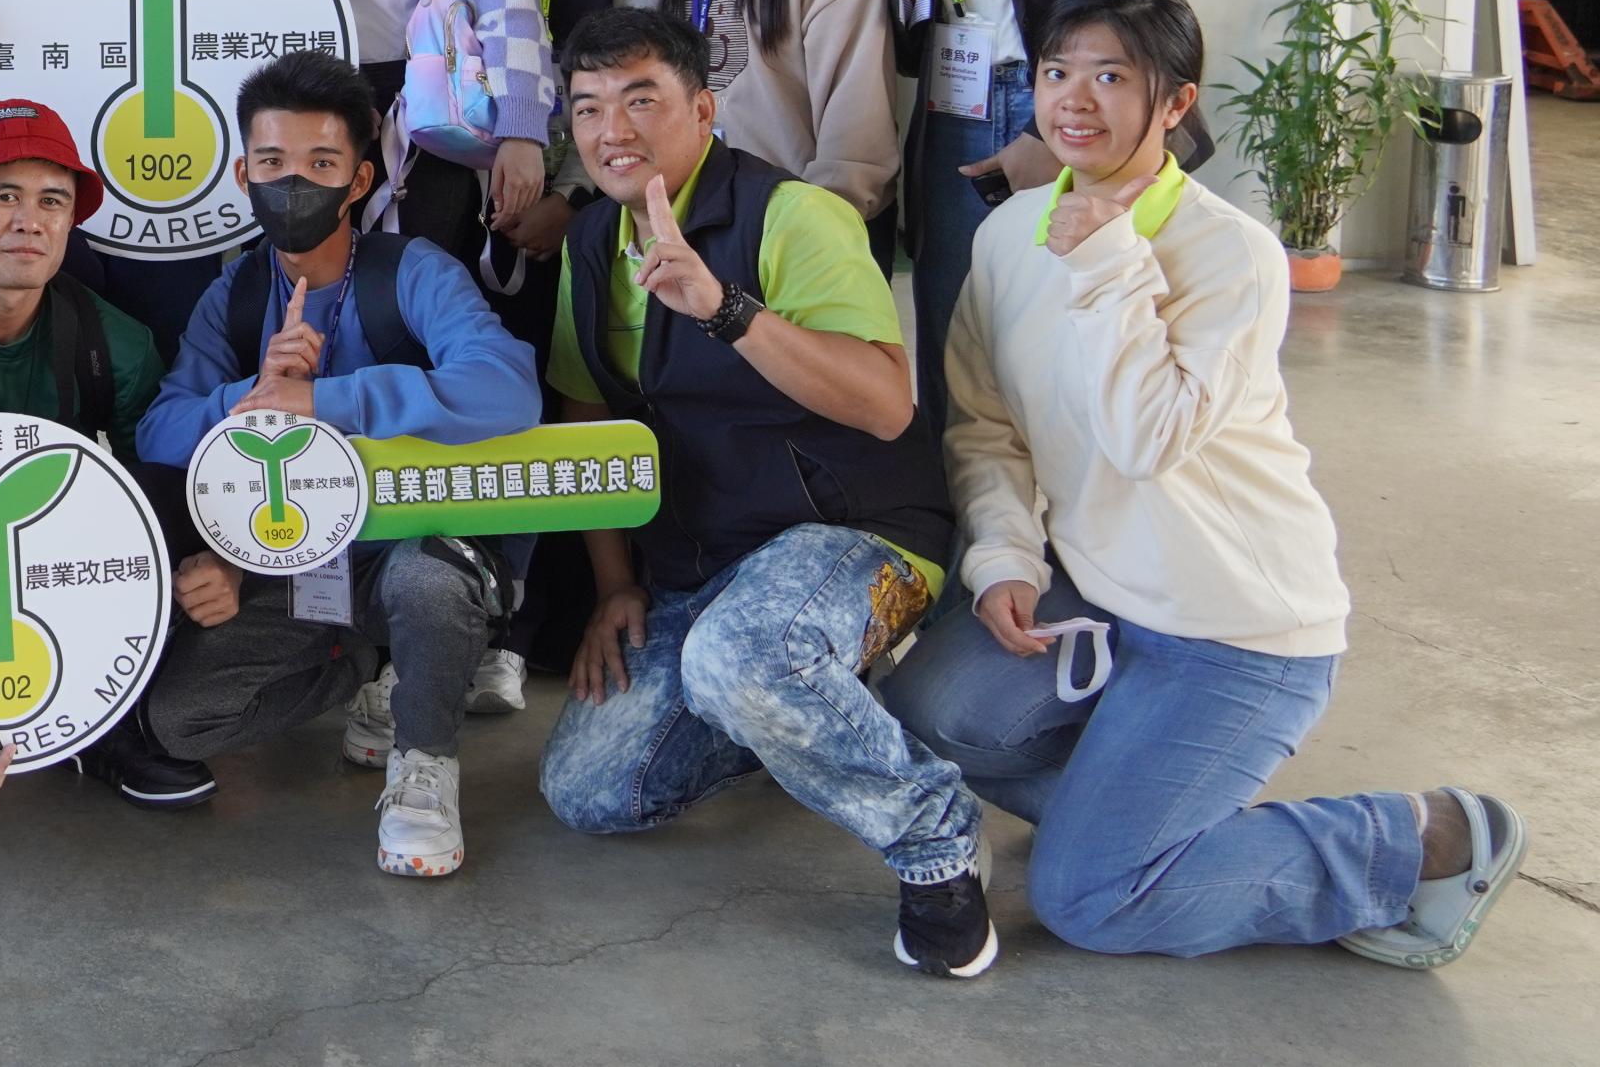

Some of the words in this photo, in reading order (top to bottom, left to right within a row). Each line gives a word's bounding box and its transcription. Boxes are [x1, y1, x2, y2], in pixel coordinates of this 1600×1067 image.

[191, 31, 338, 62] 農業改良場
[124, 153, 193, 181] 1902
[245, 413, 298, 427] 農業部
[196, 480, 263, 495] 臺南區
[289, 476, 355, 491] 農業改良場
[374, 456, 654, 505] 農業部臺南區農業改良場
[208, 520, 250, 561] Tainan
[326, 512, 353, 545] MOA
[264, 528, 294, 541] 1902
[25, 555, 151, 591] 農業改良場
[94, 634, 148, 705] MOA
